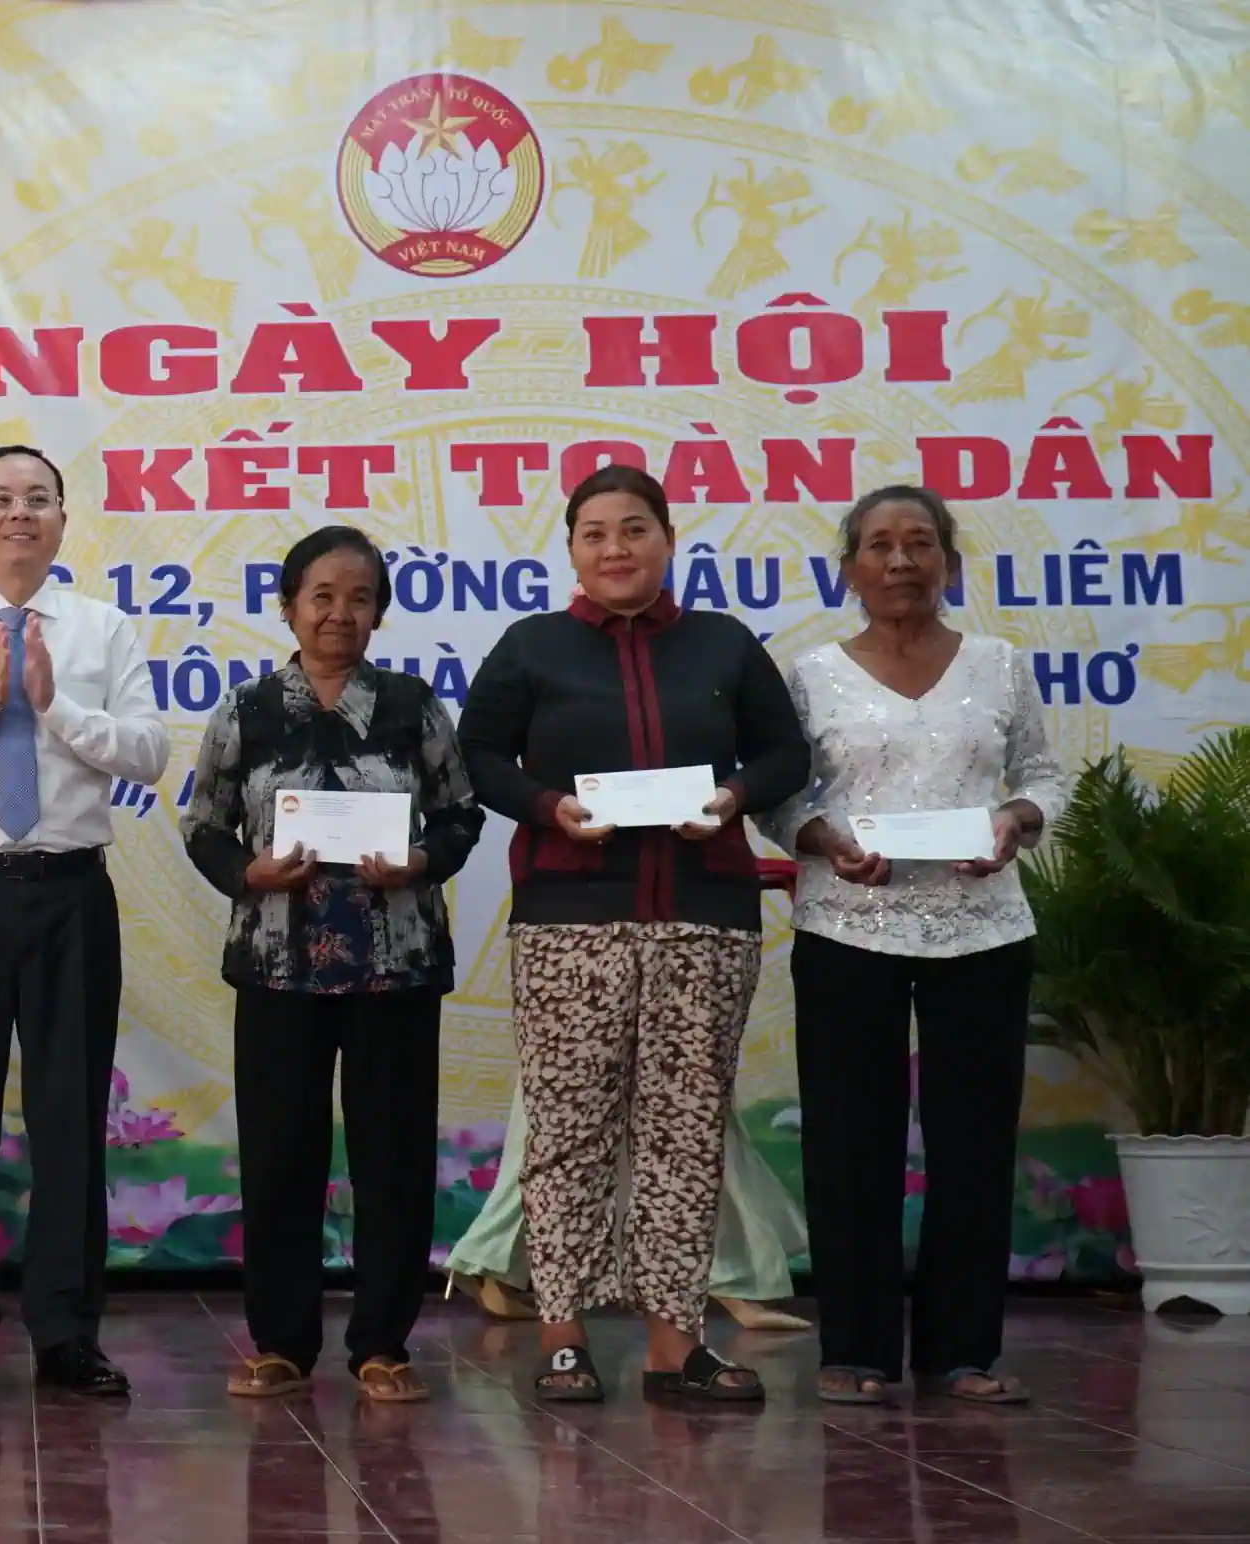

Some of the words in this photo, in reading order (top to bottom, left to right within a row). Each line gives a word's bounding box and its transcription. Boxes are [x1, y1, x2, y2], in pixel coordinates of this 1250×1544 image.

[445, 239, 487, 261] NAM
[582, 292, 951, 405] HỘI
[103, 422, 395, 511] KẾT
[916, 416, 1214, 501] DÂN
[107, 564, 213, 627] 12,
[997, 539, 1184, 607] LIÊM
